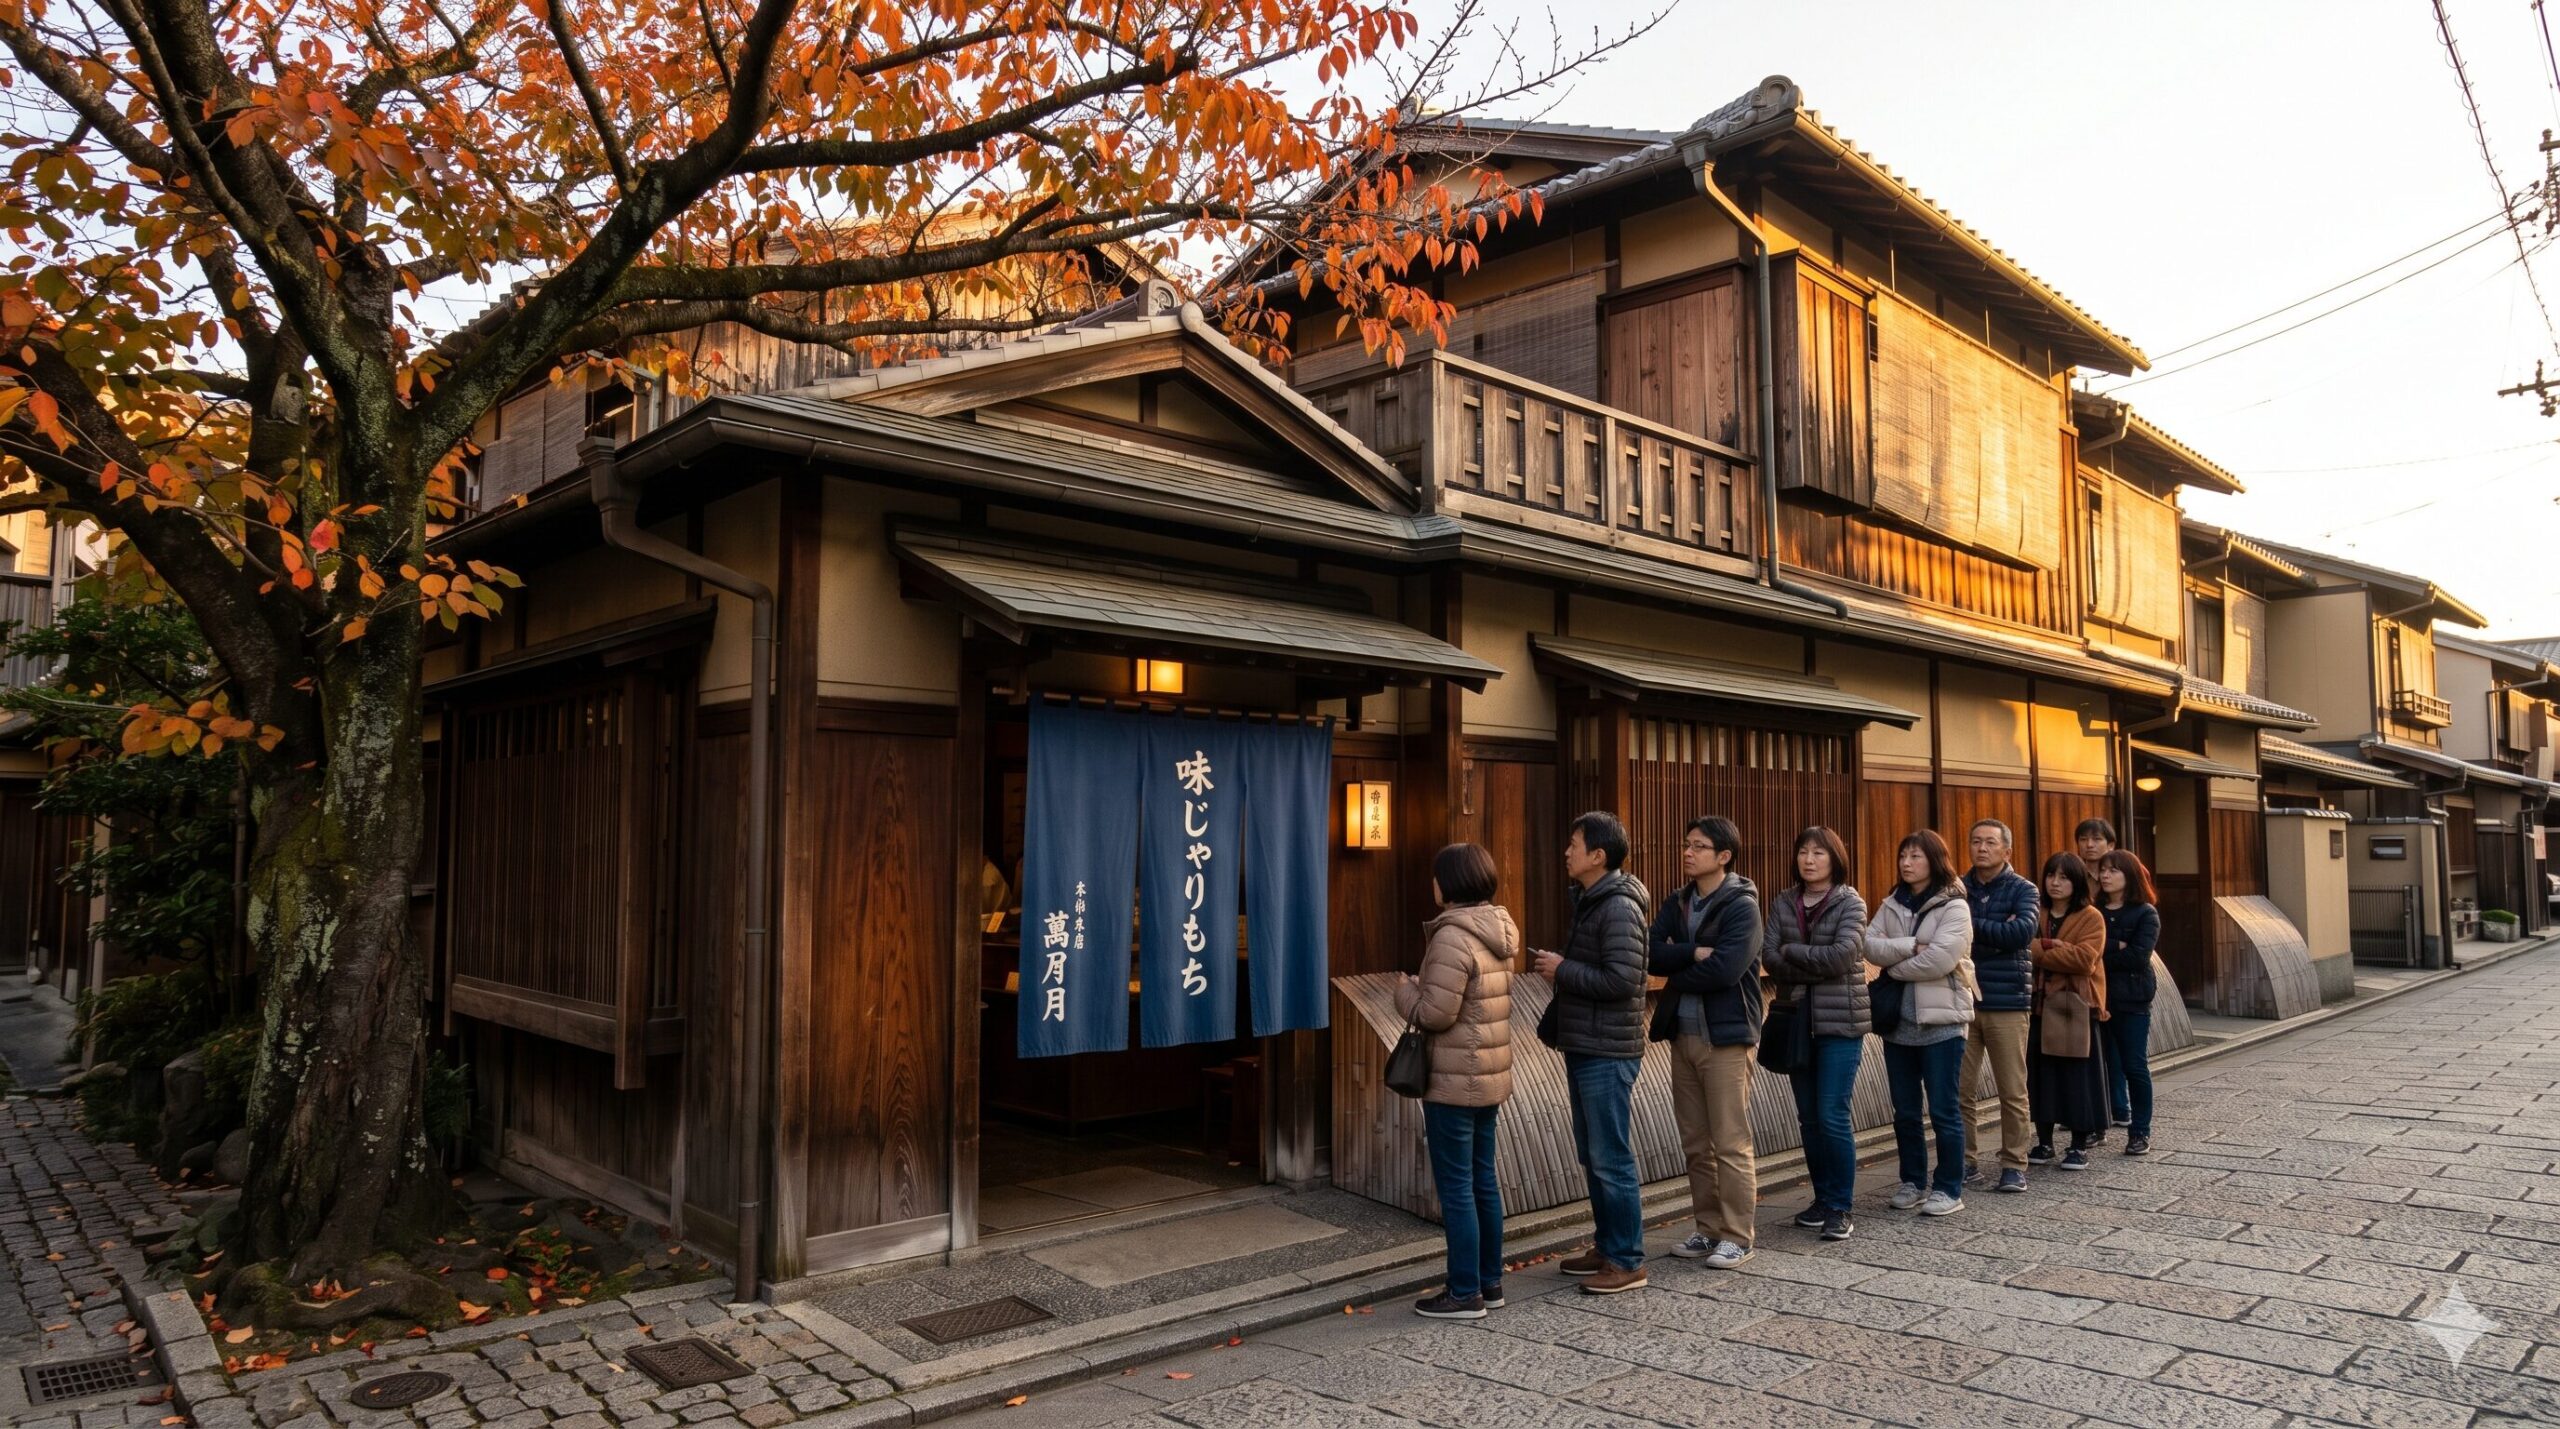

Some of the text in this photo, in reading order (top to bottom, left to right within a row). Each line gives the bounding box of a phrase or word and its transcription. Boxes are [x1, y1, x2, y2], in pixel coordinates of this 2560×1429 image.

[1176, 750, 1214, 996] 味じゃりもち
